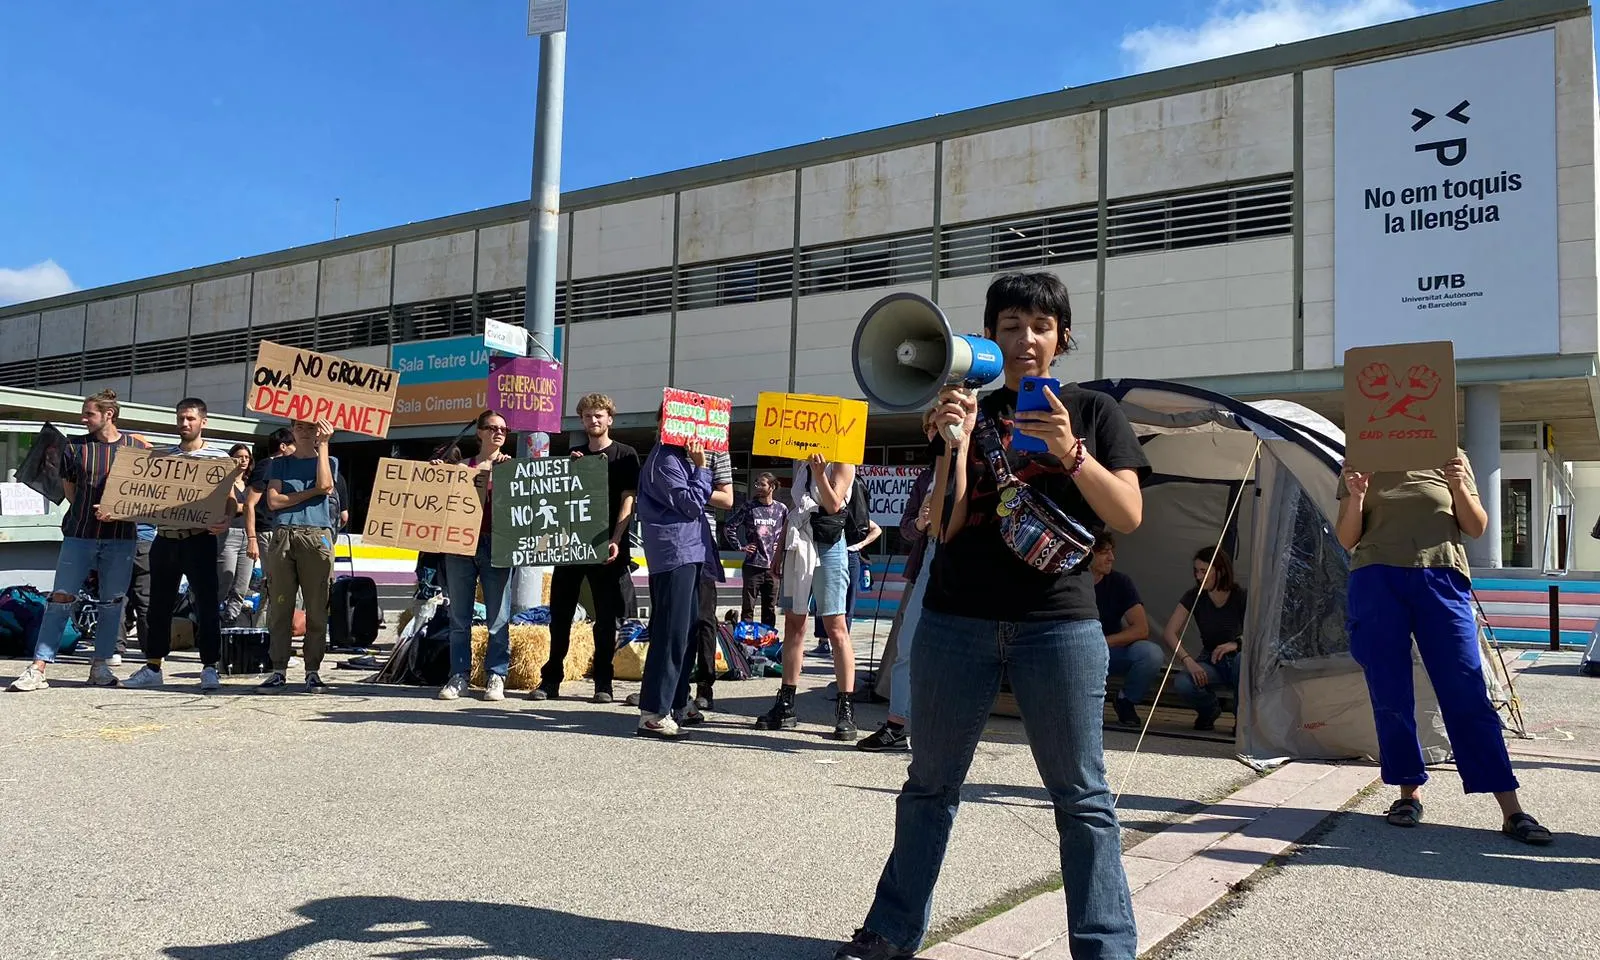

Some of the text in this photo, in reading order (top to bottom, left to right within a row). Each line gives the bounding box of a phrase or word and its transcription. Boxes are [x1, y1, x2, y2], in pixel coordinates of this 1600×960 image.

[1364, 170, 1522, 210] No em toquis
[1384, 204, 1500, 234] la llengua
[1418, 273, 1466, 291] UAB
[1401, 291, 1483, 303] Universitat Autònoma
[1428, 301, 1467, 309] Barcelona
[292, 353, 323, 378] NO
[398, 357, 424, 373] Sala
[428, 355, 466, 369] Teatre
[396, 392, 488, 413] Sala Cinema U
[764, 407, 856, 437] DEGROW
[1359, 429, 1437, 440] END FOSSIL
[132, 457, 199, 482] SYSTEM
[385, 464, 486, 488] EL NOSTRE
[514, 458, 570, 479] AQUEST
[119, 480, 203, 502] CHANGE NOT
[510, 475, 583, 497] PLANETA
[113, 500, 212, 524] CLIMATE CHANGE
[446, 492, 476, 514] ÉS
[510, 495, 592, 527] NO TÉ
[367, 520, 475, 546] DE TOTES
